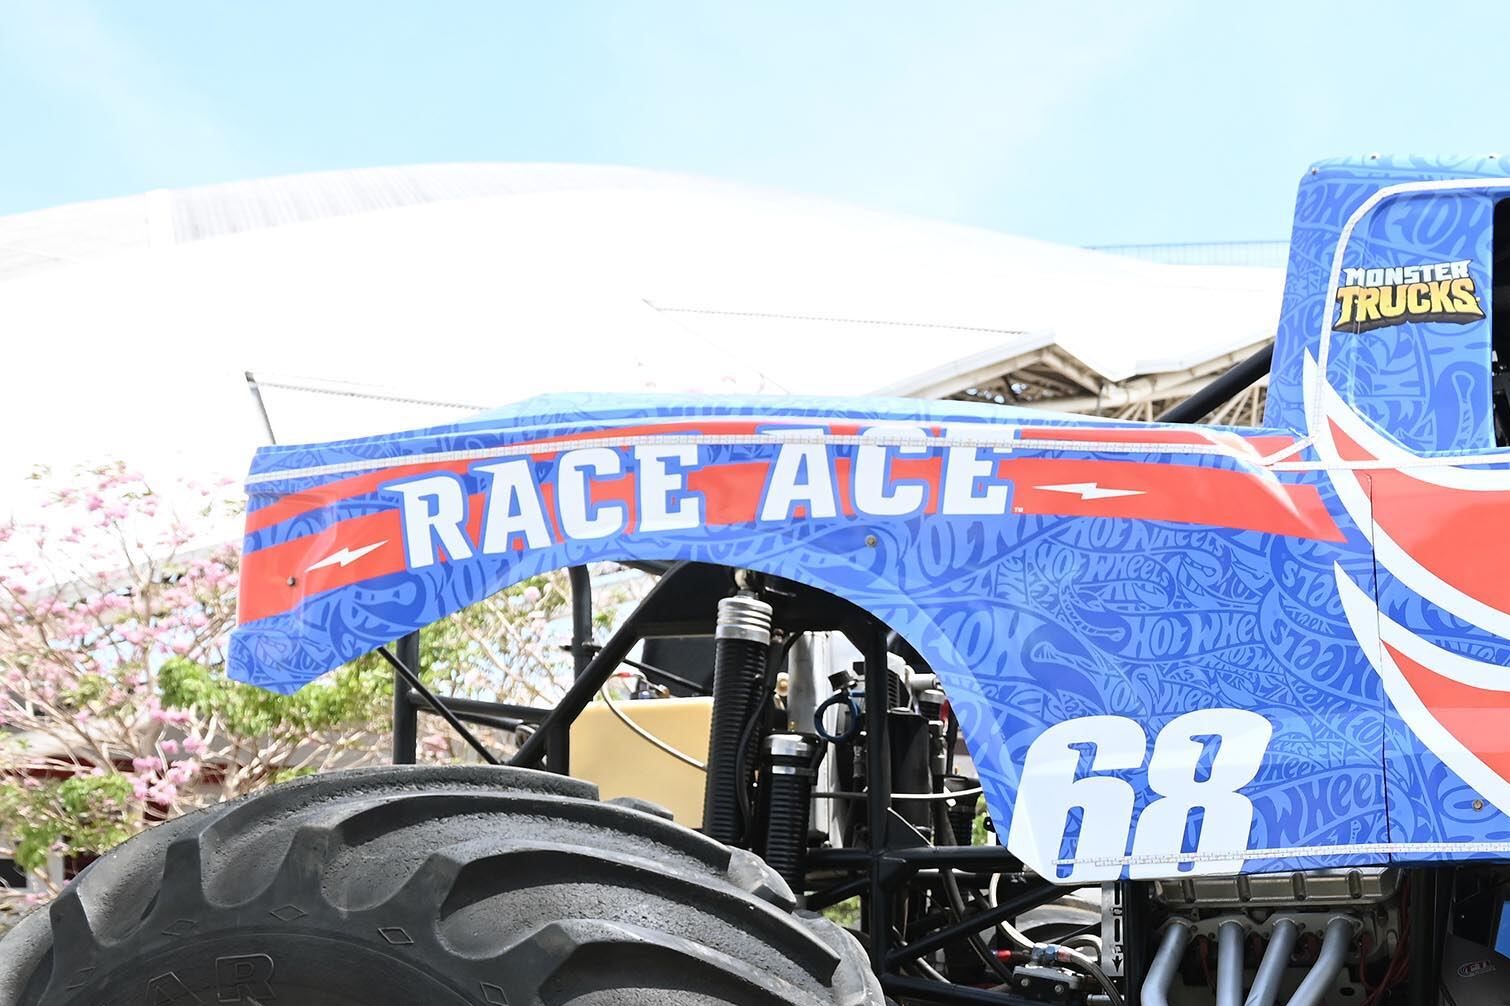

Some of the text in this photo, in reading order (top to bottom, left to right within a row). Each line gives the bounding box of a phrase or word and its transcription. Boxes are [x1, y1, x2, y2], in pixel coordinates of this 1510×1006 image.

[1334, 278, 1485, 330] TRUCKS
[1343, 258, 1473, 288] MONSTER
[383, 426, 1016, 569] RACE ACE
[1008, 707, 1274, 885] 68
